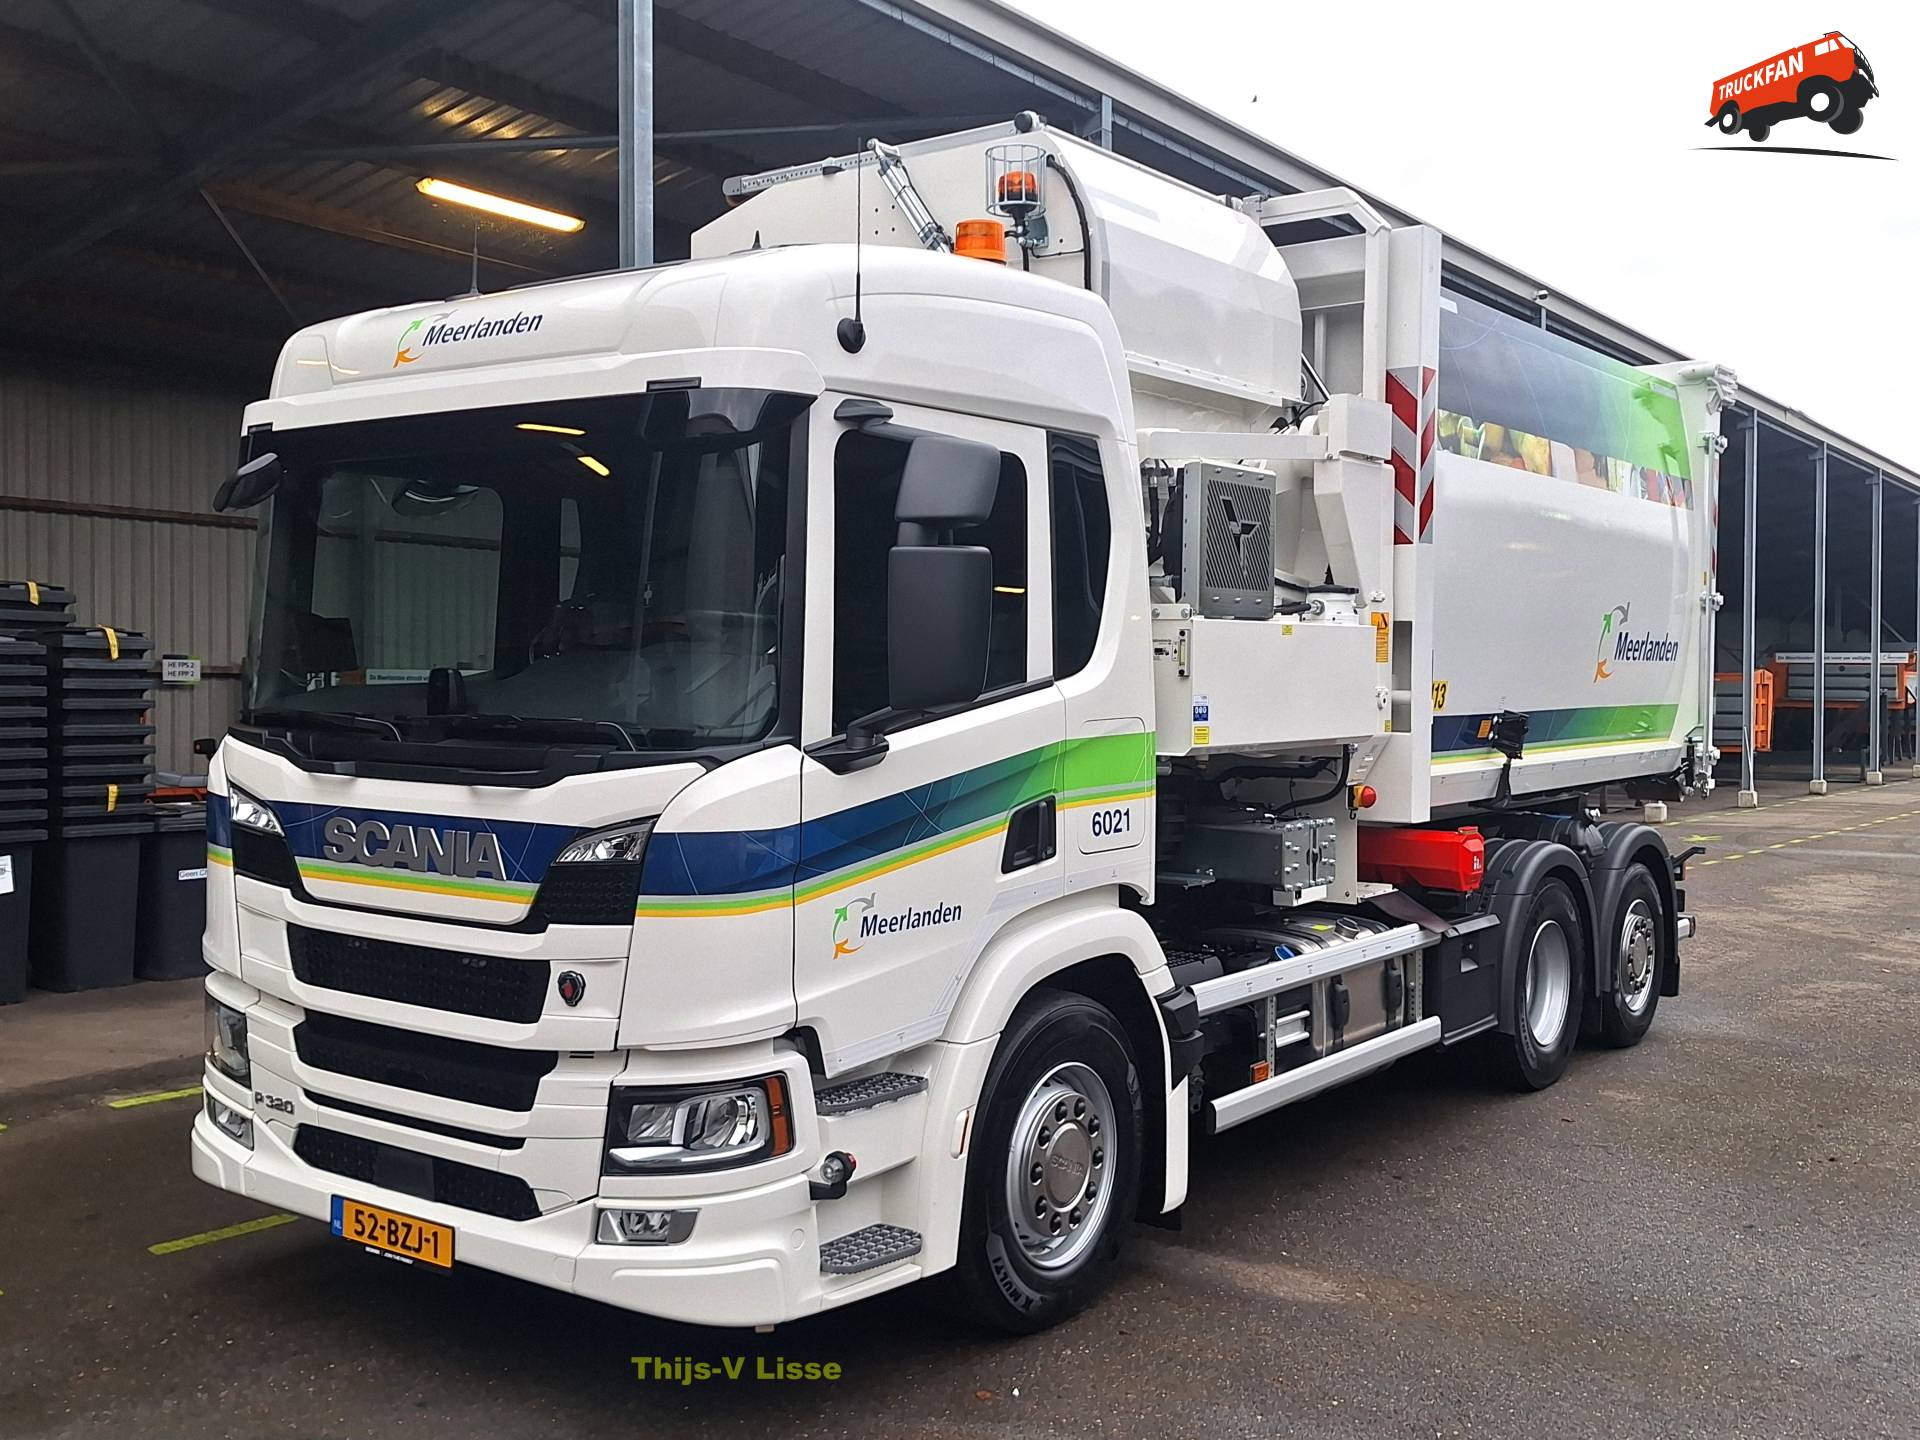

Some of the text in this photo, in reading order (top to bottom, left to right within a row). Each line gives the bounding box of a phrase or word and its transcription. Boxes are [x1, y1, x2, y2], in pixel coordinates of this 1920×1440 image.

[422, 311, 543, 347] Meerlanden
[1614, 631, 1679, 662] Meerlanden
[1432, 683, 1447, 710] 13
[1092, 807, 1130, 837] 6021
[323, 816, 507, 881] SCANIA
[860, 901, 962, 938] Meerlanden
[255, 1091, 295, 1115] P 320
[333, 1218, 343, 1230] NL
[353, 1208, 439, 1260] 52-BZJ-1
[992, 1256, 1023, 1303] MULTI
